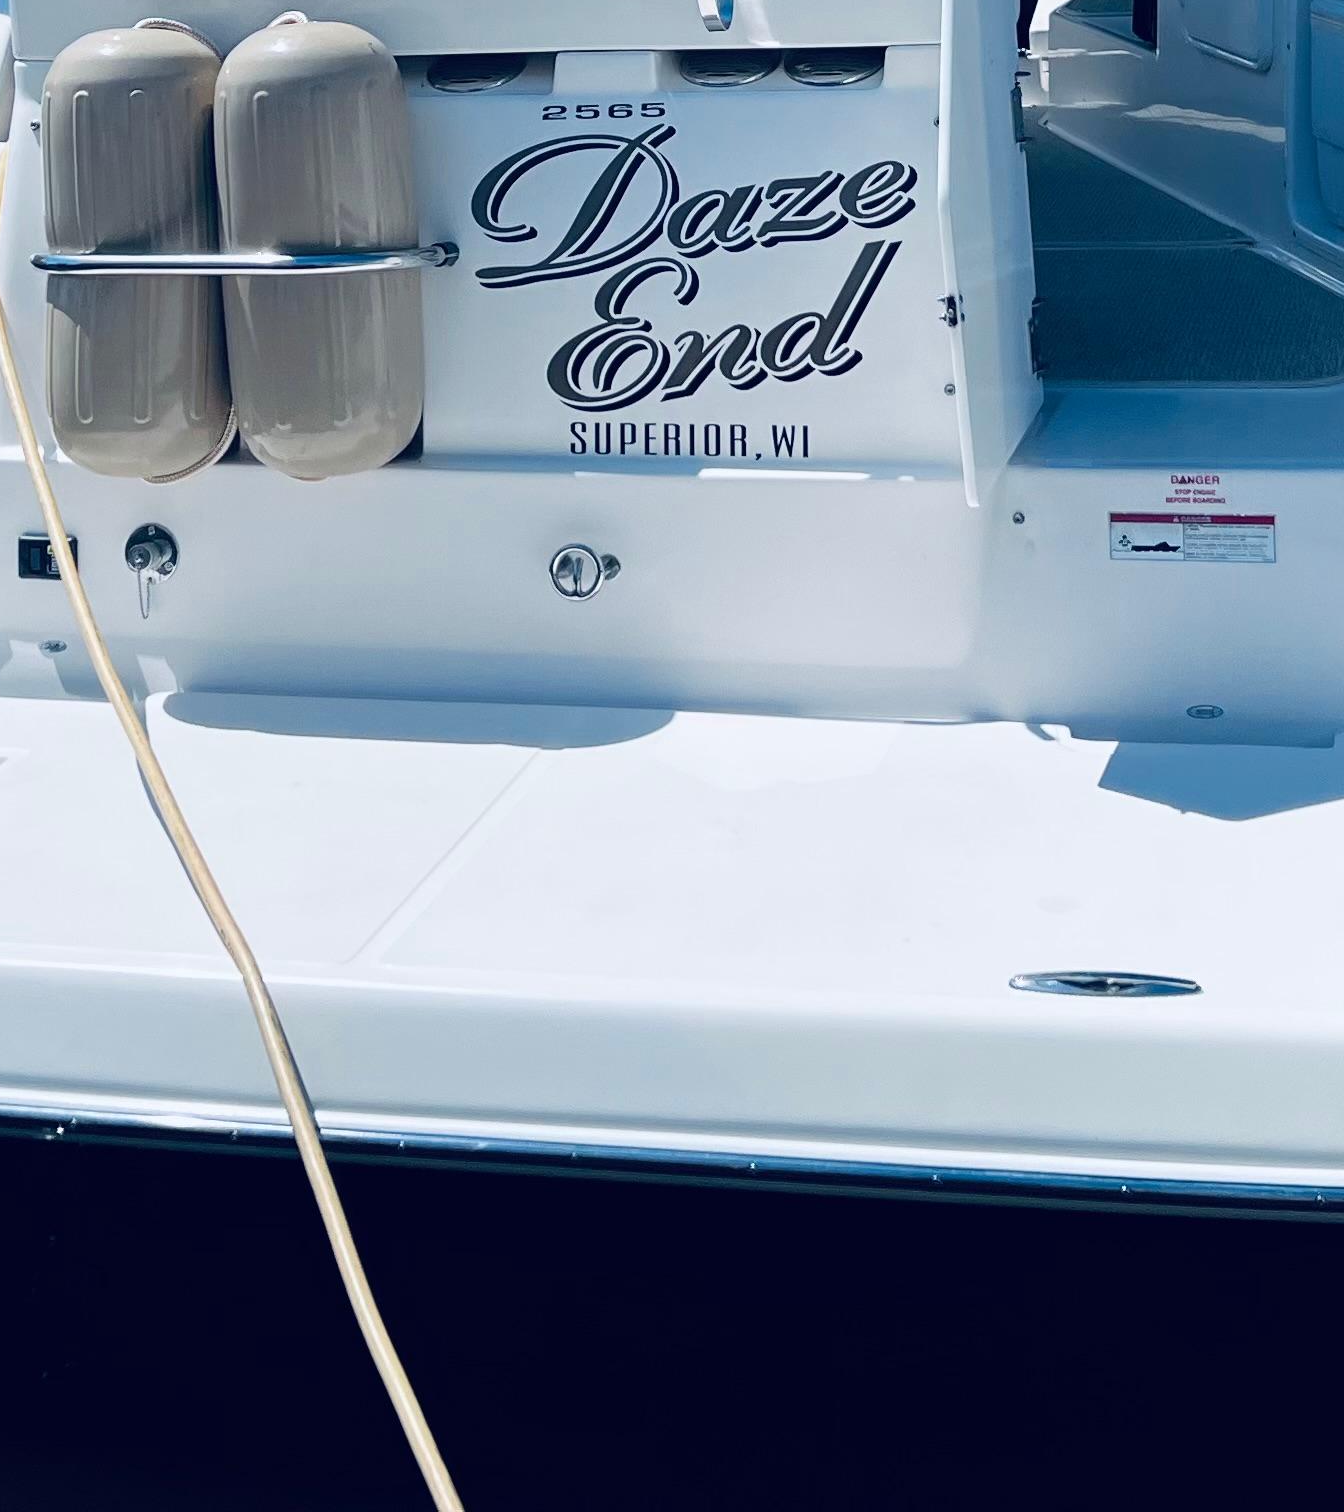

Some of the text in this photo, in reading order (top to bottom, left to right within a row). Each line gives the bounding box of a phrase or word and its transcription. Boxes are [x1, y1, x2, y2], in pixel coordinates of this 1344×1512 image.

[541, 101, 668, 121] 2565
[470, 122, 919, 289] Daze
[545, 239, 903, 413] End
[1170, 474, 1220, 485] DANGER
